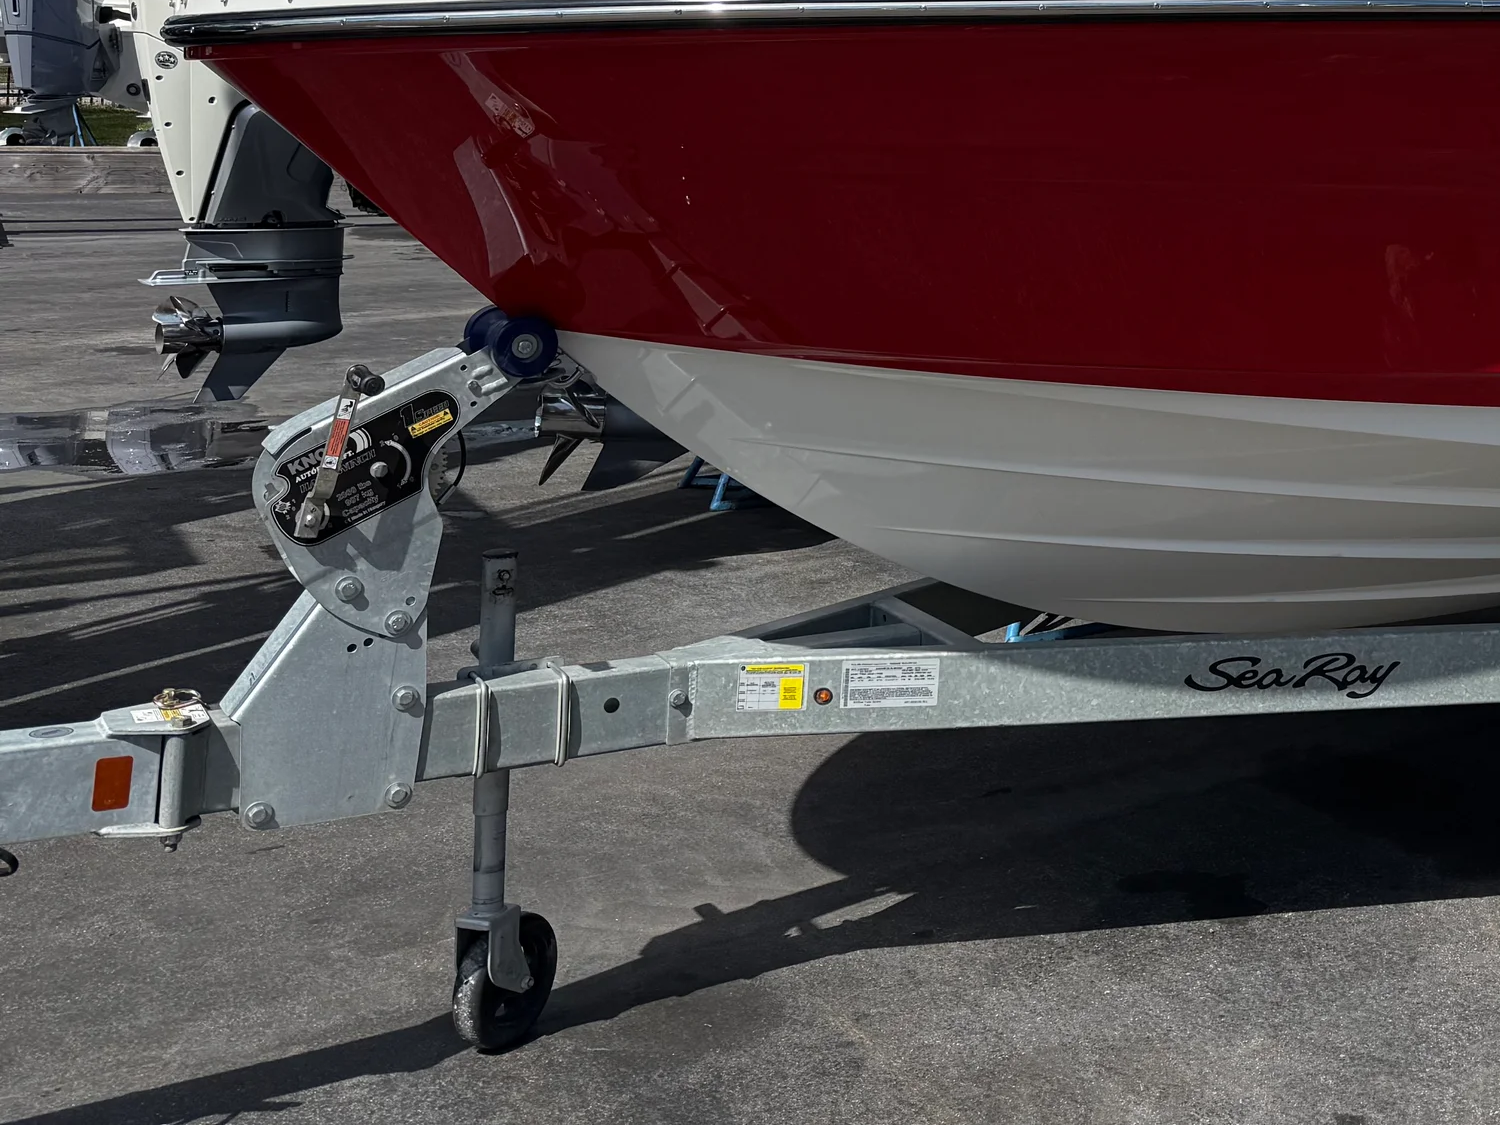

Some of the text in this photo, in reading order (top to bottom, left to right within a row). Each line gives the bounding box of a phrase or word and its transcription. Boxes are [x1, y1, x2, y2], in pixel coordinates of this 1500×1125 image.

[295, 465, 321, 484] AUTÓ
[1184, 652, 1401, 699] Sea Ray
